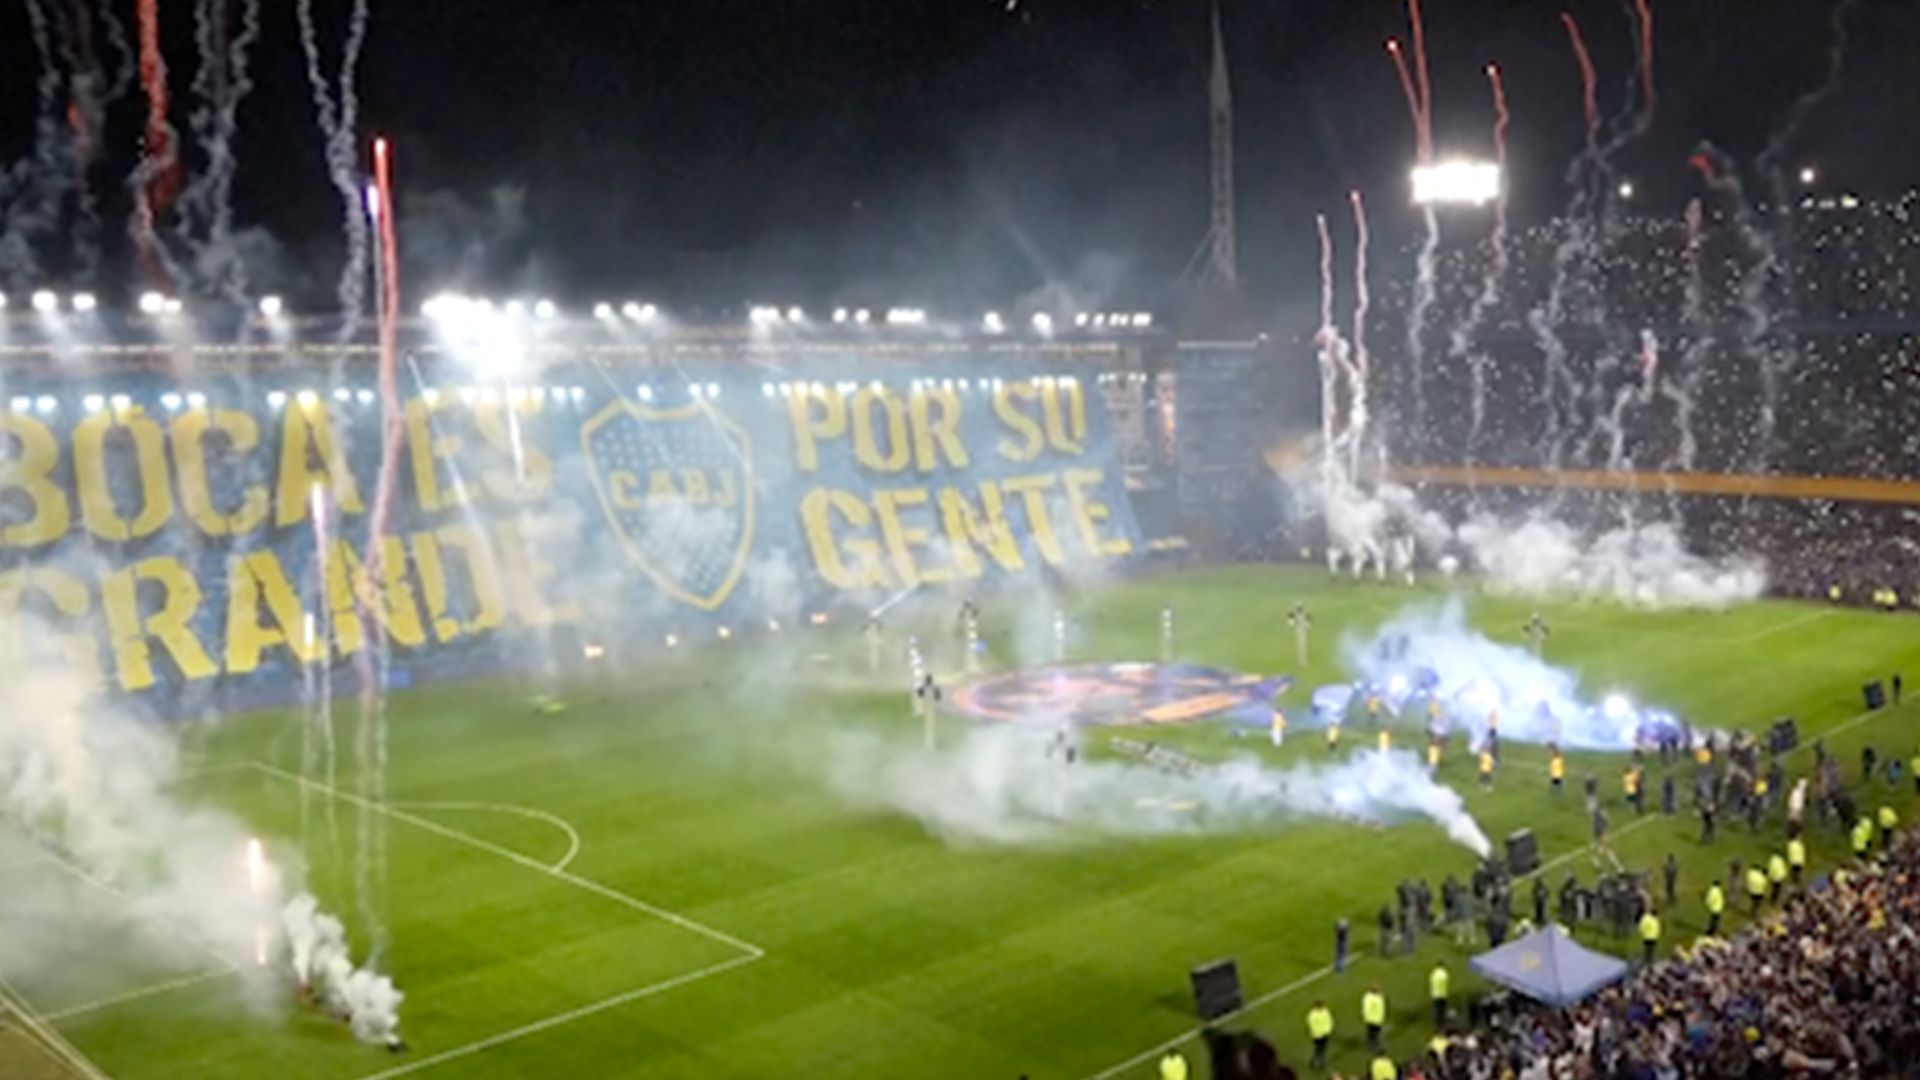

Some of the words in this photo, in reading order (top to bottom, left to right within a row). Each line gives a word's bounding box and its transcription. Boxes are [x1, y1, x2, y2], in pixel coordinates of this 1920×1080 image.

[0, 392, 364, 547] BOCA
[406, 388, 554, 512] ES
[789, 380, 970, 472] POR
[993, 377, 1086, 463] SU
[801, 467, 1132, 588] GENTE
